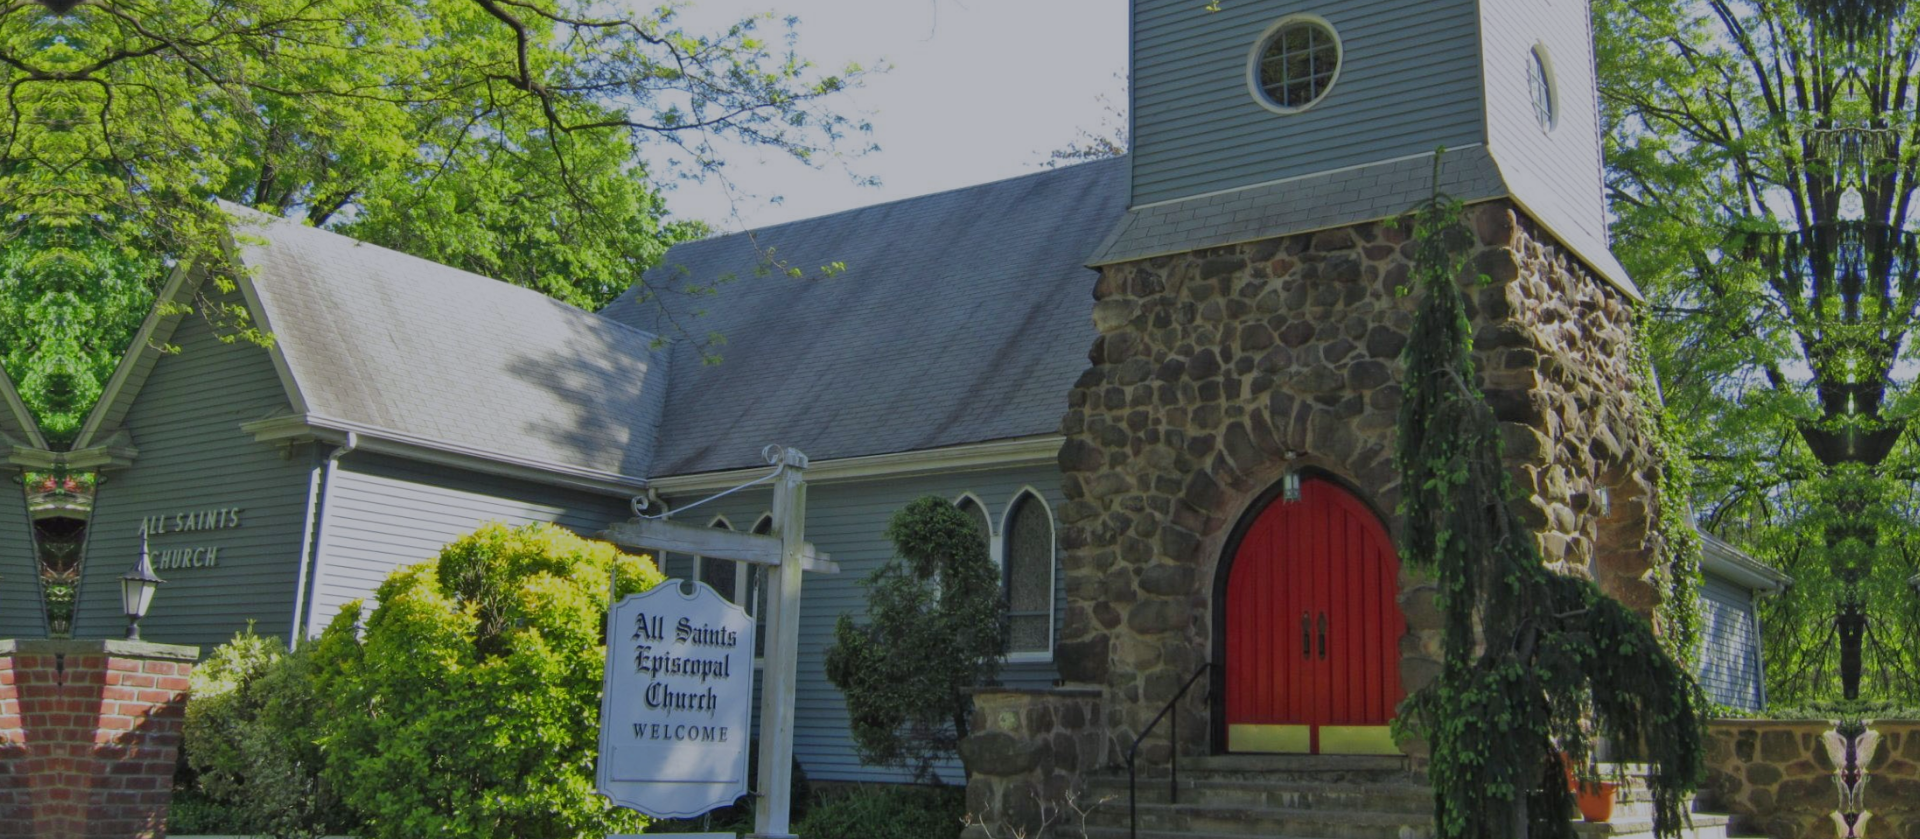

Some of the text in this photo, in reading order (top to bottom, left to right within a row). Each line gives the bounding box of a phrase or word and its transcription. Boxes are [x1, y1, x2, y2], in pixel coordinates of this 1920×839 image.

[138, 507, 240, 535] ALL SAINTS
[149, 546, 217, 569] CHURCH
[632, 612, 737, 646] All Saints
[634, 645, 731, 682] Episcopal
[644, 681, 717, 718] Church
[632, 723, 729, 743] WELCOME
